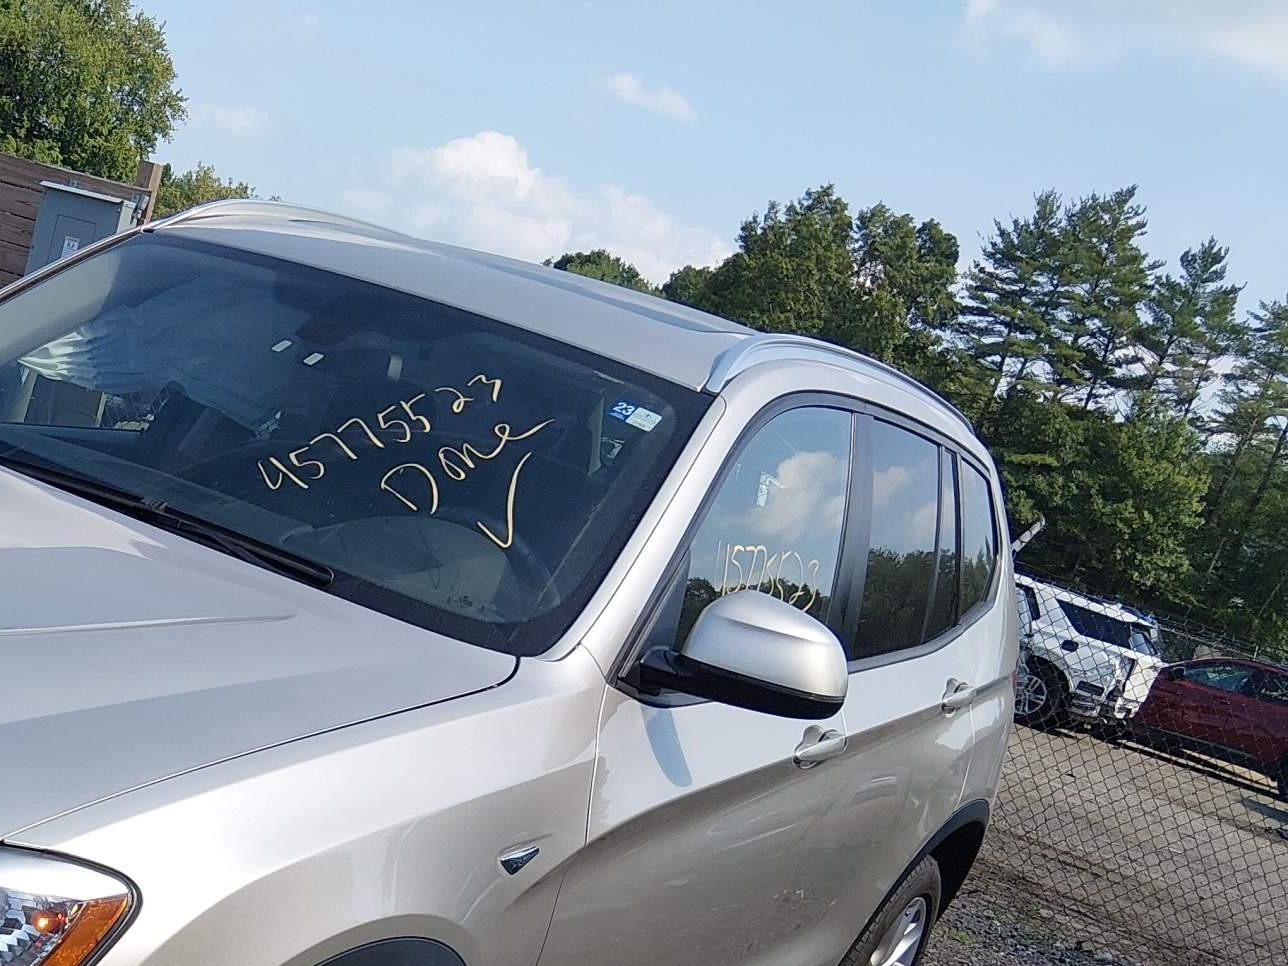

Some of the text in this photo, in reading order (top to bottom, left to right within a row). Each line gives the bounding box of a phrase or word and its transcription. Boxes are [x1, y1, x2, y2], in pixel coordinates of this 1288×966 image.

[257, 374, 503, 490] 45775523
[612, 402, 636, 416] 23
[380, 418, 556, 515] Done
